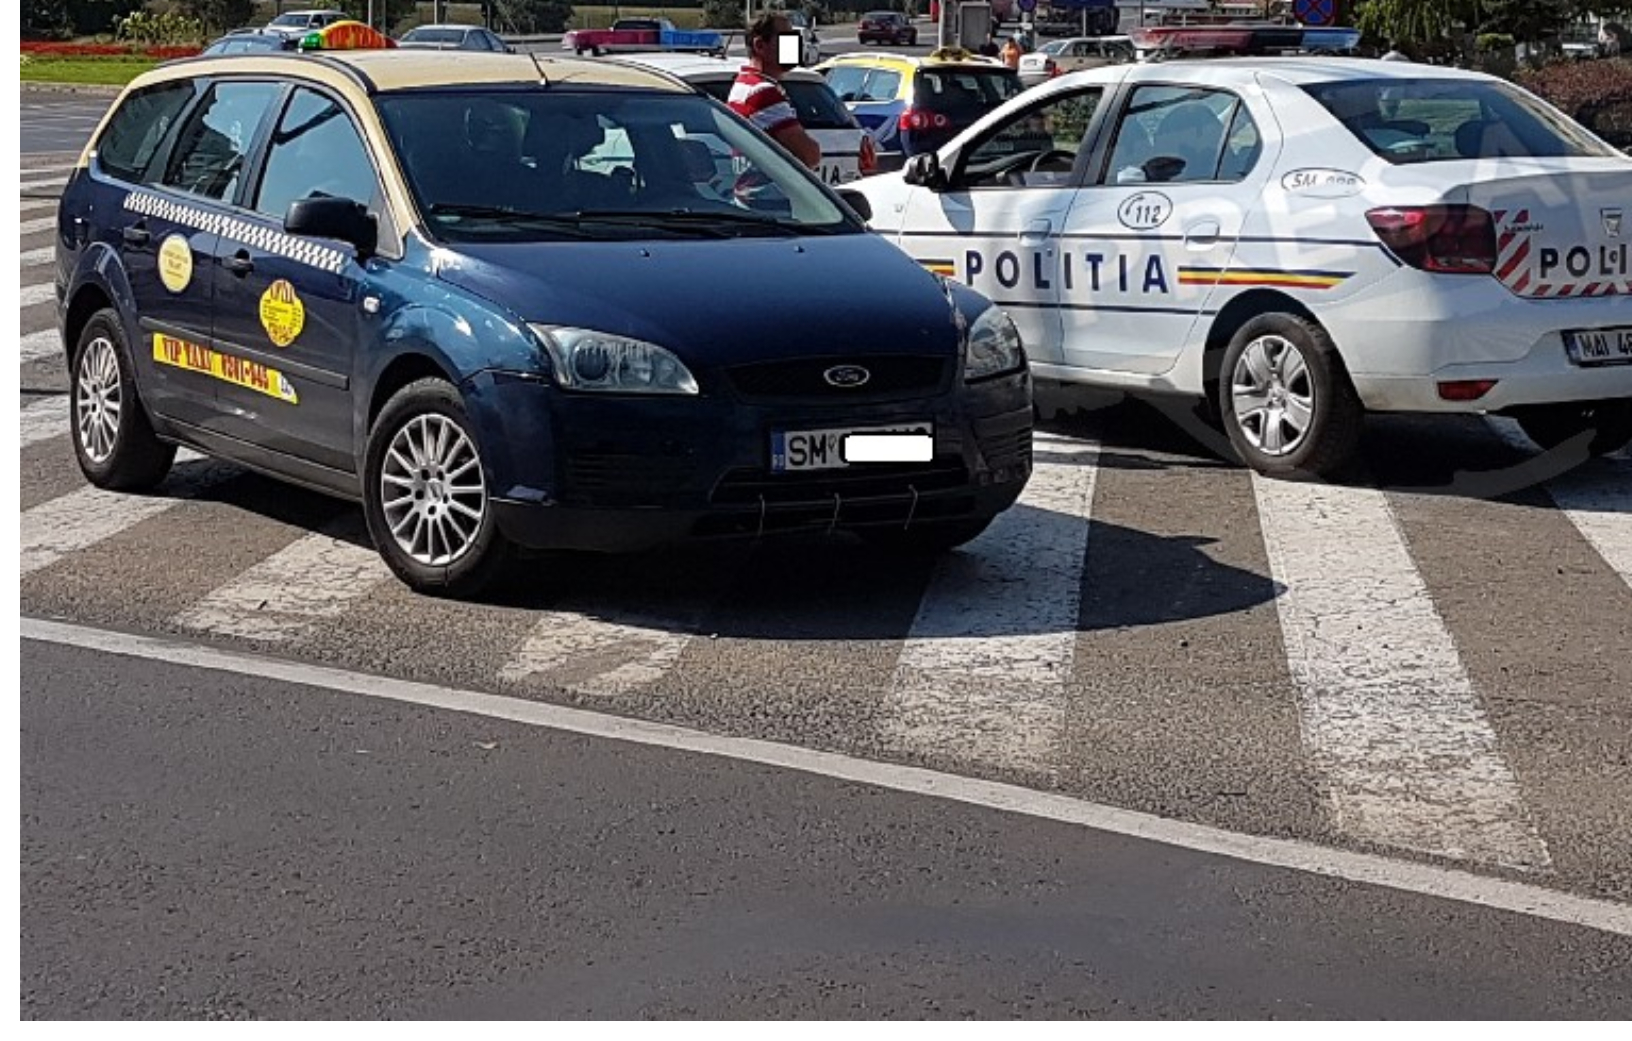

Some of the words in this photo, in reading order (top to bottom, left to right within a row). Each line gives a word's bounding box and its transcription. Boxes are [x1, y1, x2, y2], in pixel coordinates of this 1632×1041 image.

[1136, 205, 1161, 224] 112
[966, 249, 1170, 293] POLITIA
[1580, 332, 1609, 357] MAI
[788, 434, 827, 467] SM
